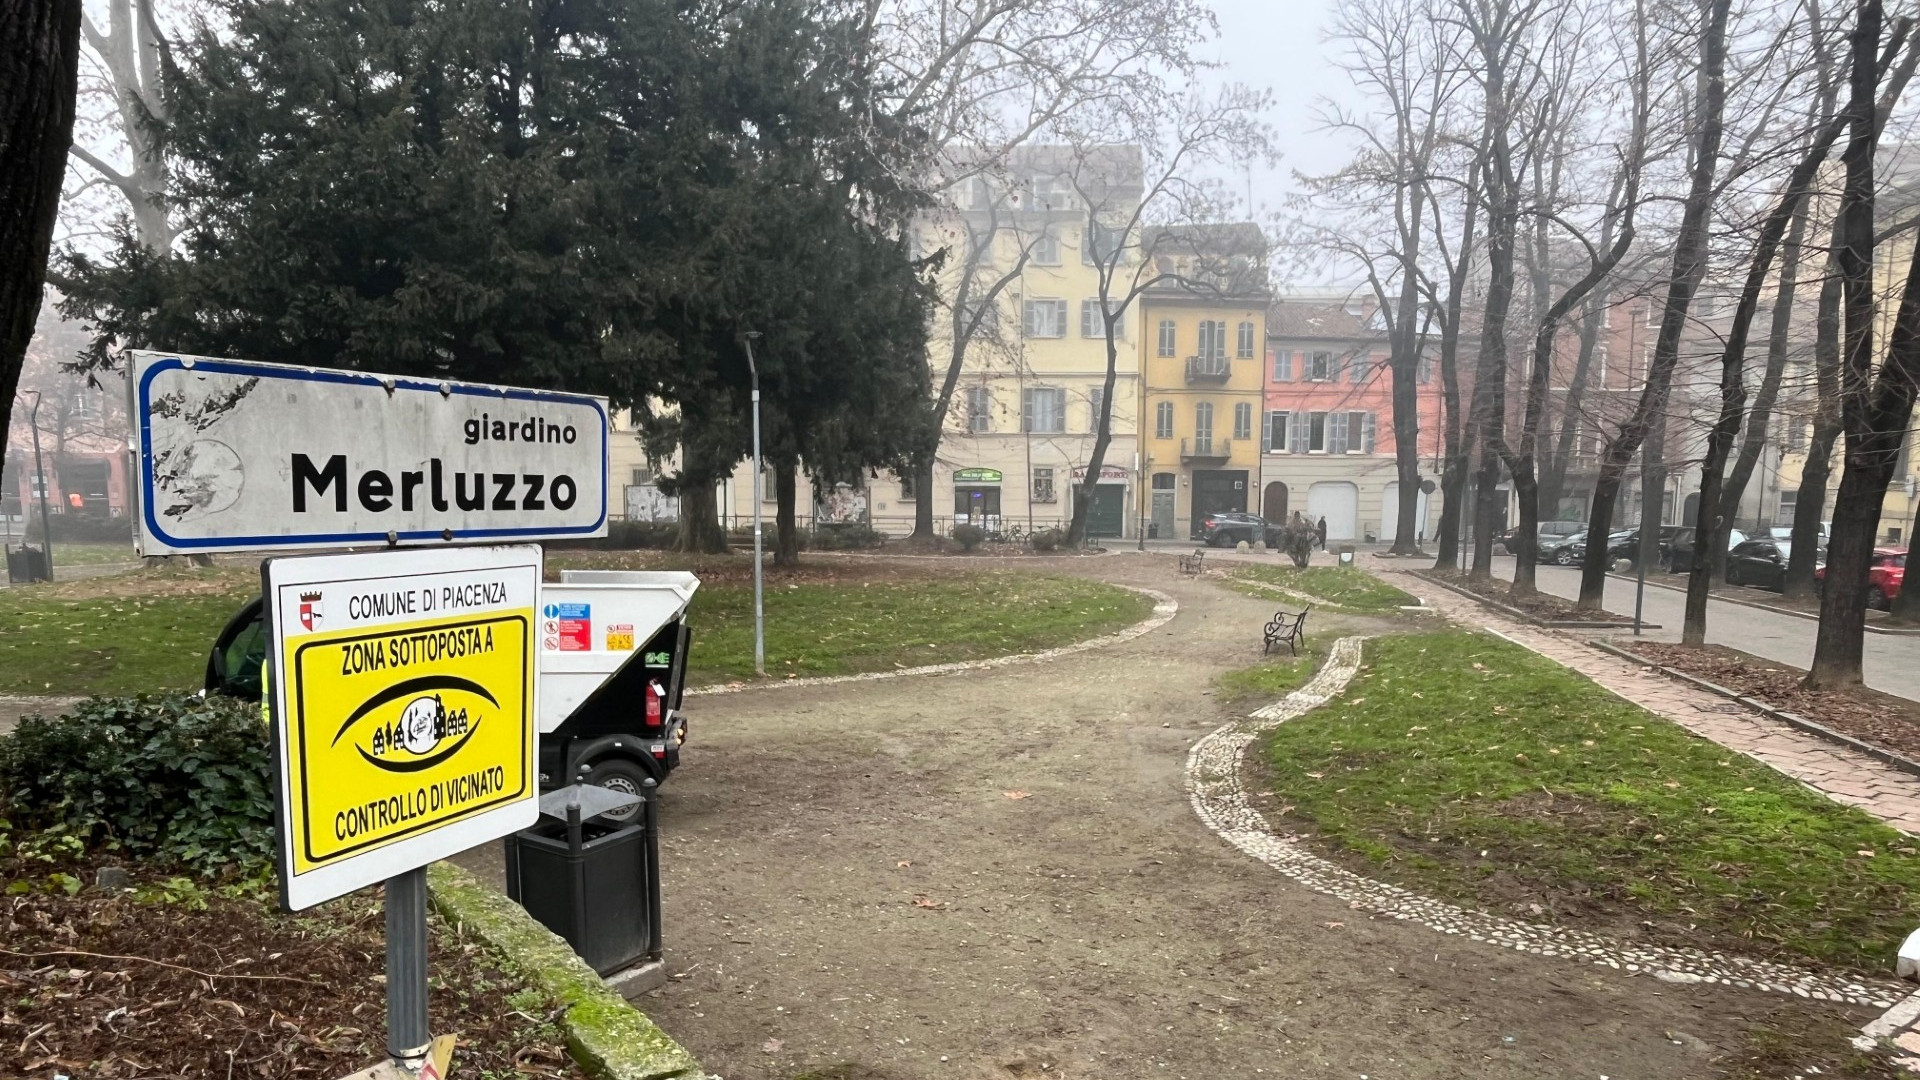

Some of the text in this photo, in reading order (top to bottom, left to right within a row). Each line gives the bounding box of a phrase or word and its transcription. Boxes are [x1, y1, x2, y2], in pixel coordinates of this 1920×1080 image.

[464, 413, 577, 445] giardino
[291, 453, 577, 512] Merluzzo
[349, 582, 507, 620] COMUNE DI PIACENZA
[342, 625, 494, 676] ZONA SOTTOPOSTA A
[335, 765, 504, 841] CONTROLLO DI VICINATO
